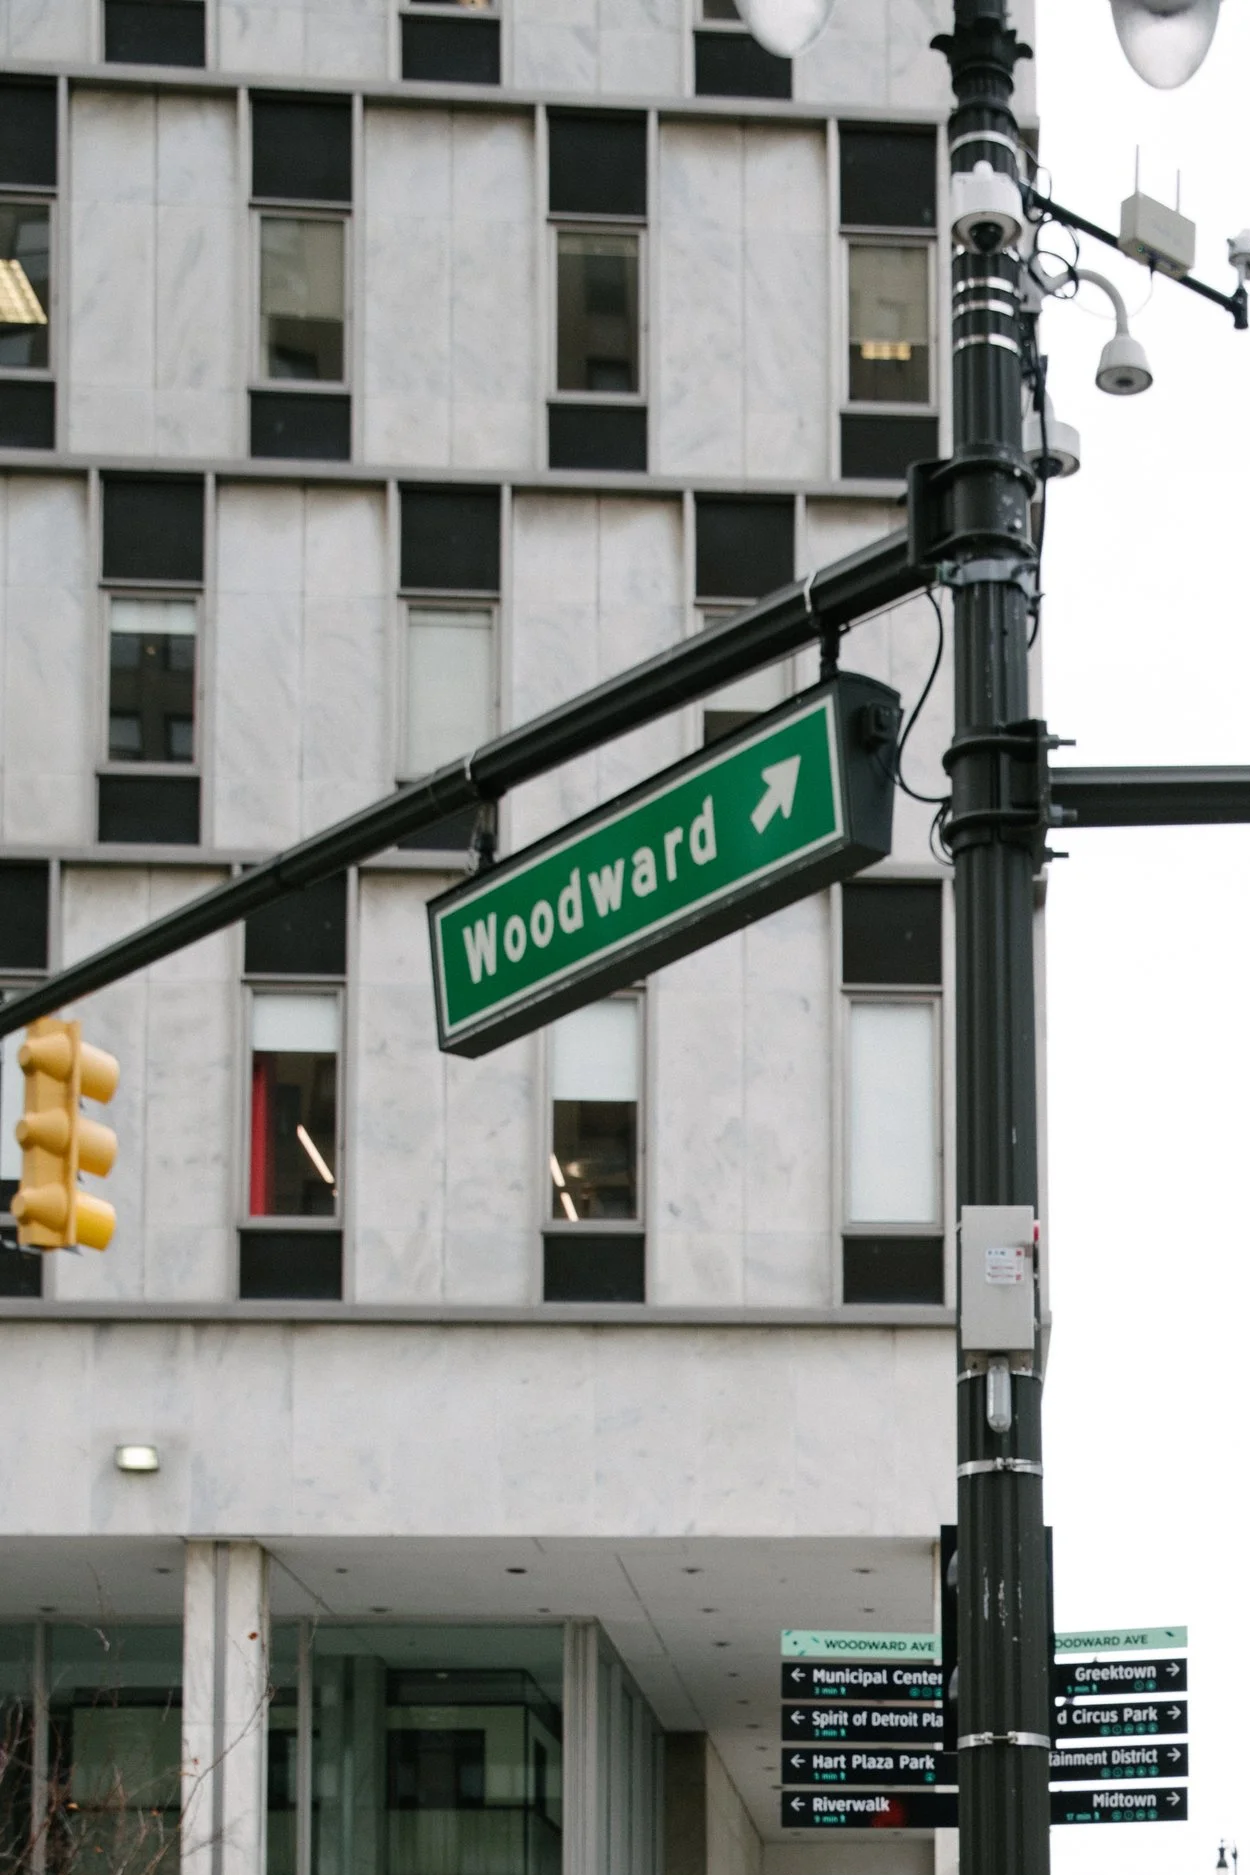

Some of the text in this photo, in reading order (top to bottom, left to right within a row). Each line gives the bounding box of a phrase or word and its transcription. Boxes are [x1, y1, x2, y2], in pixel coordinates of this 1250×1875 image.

[462, 795, 717, 984] Woodward
[824, 1640, 935, 1652] WOODWARD AVE
[1124, 1634, 1149, 1645] AVE
[812, 1668, 888, 1687] Municipal
[1075, 1665, 1157, 1682] Greektown
[812, 1710, 849, 1728] Spirit
[852, 1711, 868, 1726] of
[871, 1711, 918, 1726] Detroit
[1072, 1708, 1119, 1724] Circus
[1123, 1706, 1158, 1722] Park
[812, 1754, 936, 1769] Hart Plaza Park
[1111, 1748, 1158, 1764] District
[812, 1797, 890, 1812] Riverwalk
[1092, 1792, 1157, 1808] Midtown
